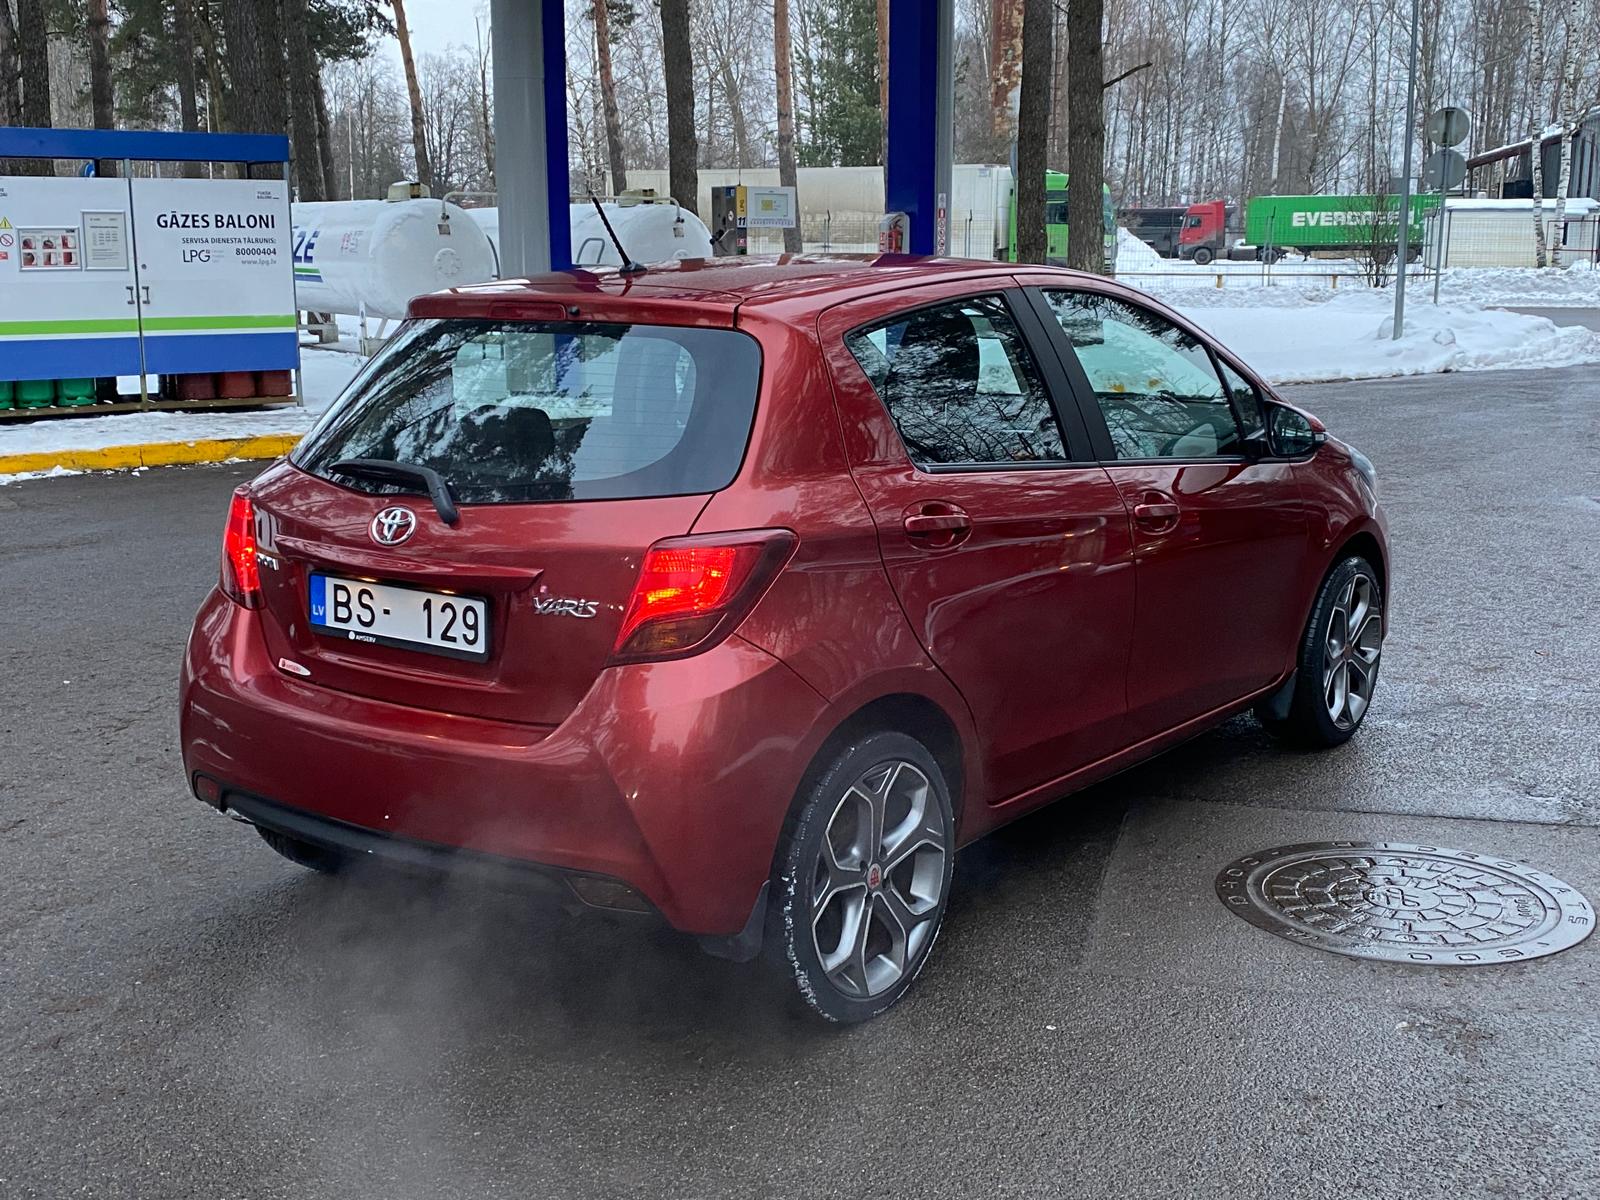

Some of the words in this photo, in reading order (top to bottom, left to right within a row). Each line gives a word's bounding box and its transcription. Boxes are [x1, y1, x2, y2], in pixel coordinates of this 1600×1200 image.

[157, 211, 210, 228] GĀZES
[214, 214, 275, 228] BALONI
[737, 216, 746, 226] 11
[292, 225, 320, 263] ZE
[183, 249, 211, 263] LPG
[236, 248, 277, 256] 80000404
[312, 604, 325, 617] LV
[333, 583, 391, 628] BS-
[422, 598, 479, 646] 129
[532, 596, 601, 618] YARIS
